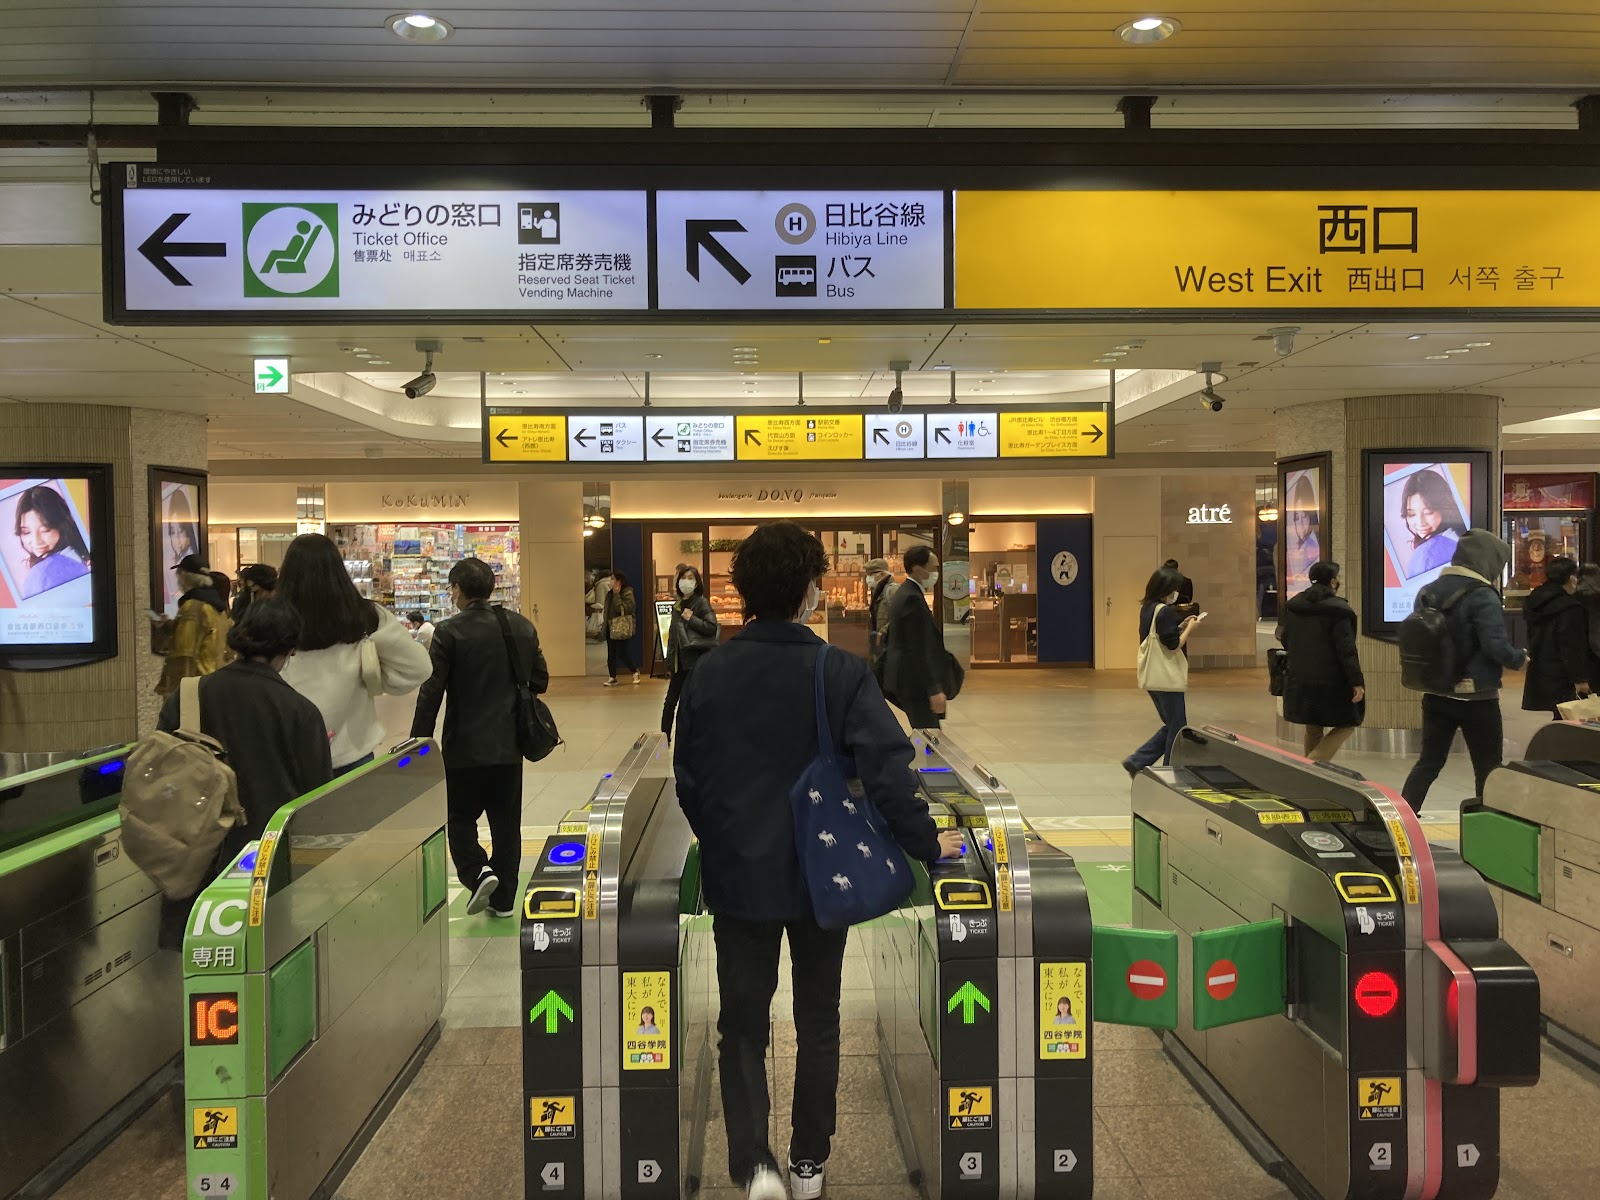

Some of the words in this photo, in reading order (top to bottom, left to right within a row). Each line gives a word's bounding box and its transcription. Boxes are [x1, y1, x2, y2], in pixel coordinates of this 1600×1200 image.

[352, 202, 501, 228] みどりの窓口
[825, 202, 926, 228] 日比谷線
[788, 216, 802, 230] H
[1317, 204, 1418, 254] 西口
[352, 232, 399, 246] Ticket
[403, 232, 447, 246] Office
[826, 232, 872, 248] Hibiya
[877, 232, 908, 246] Line
[352, 249, 392, 263] 售票处
[402, 249, 442, 262] 매표소
[518, 253, 632, 272] 指定席券売機
[826, 254, 876, 278] バス
[518, 275, 572, 285] Reserved
[574, 275, 599, 285] Seat
[602, 275, 635, 285] Ticket
[1174, 265, 1254, 293] West
[1266, 265, 1322, 293] Exit
[1347, 266, 1424, 292] 西出口
[1448, 266, 1500, 291] 서쪽
[1512, 265, 1566, 291] 출구
[518, 287, 560, 300] Vending
[563, 287, 613, 298] Machine
[826, 284, 855, 298] Bus
[757, 489, 803, 503] DONQ
[1188, 503, 1231, 522] atré
[192, 899, 248, 936] IC
[192, 946, 234, 968] 専用
[1058, 967, 1069, 989] 私が
[642, 976, 652, 999] 私が
[196, 999, 238, 1040] IC
[1044, 1031, 1082, 1039] 四谷学院
[627, 1040, 666, 1049] 四谷学院
[1059, 1155, 1068, 1167] 2
[1378, 1148, 1386, 1160] 2
[1463, 1149, 1469, 1161] 1
[967, 1157, 977, 1169] 3
[550, 1168, 559, 1180] 4
[643, 1165, 653, 1177] 3
[200, 1178, 211, 1190] 5
[220, 1177, 230, 1190] 4
